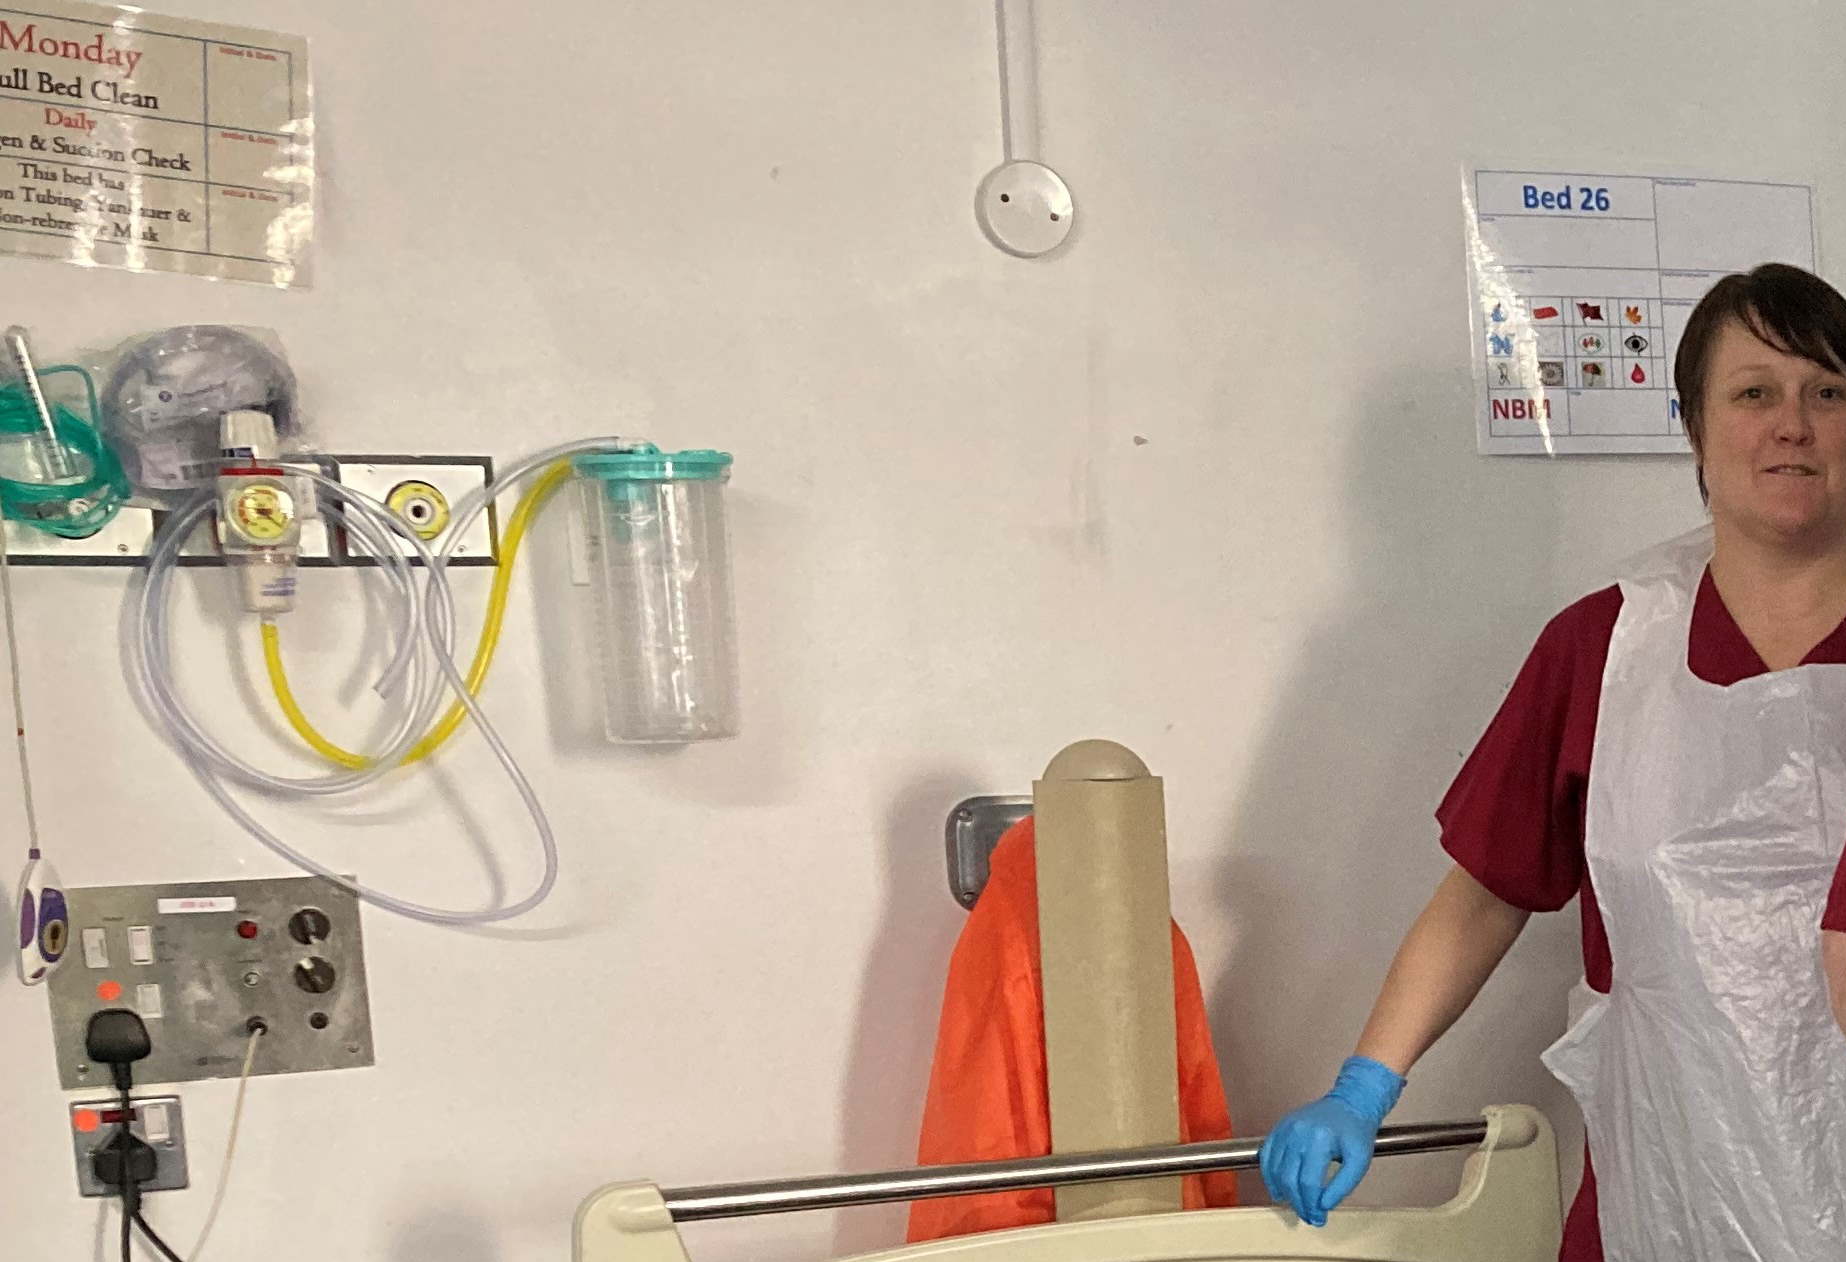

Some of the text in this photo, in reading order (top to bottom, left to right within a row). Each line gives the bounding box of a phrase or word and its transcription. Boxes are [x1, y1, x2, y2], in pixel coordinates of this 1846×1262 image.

[0, 21, 142, 78] Monday
[0, 68, 158, 109] ull Bed Clean
[44, 107, 97, 137] Daily
[30, 135, 47, 151] &
[131, 148, 192, 172] Check
[16, 162, 57, 181] This
[62, 167, 92, 187] bed
[1523, 184, 1611, 212] Bed 26
[177, 208, 191, 223] &
